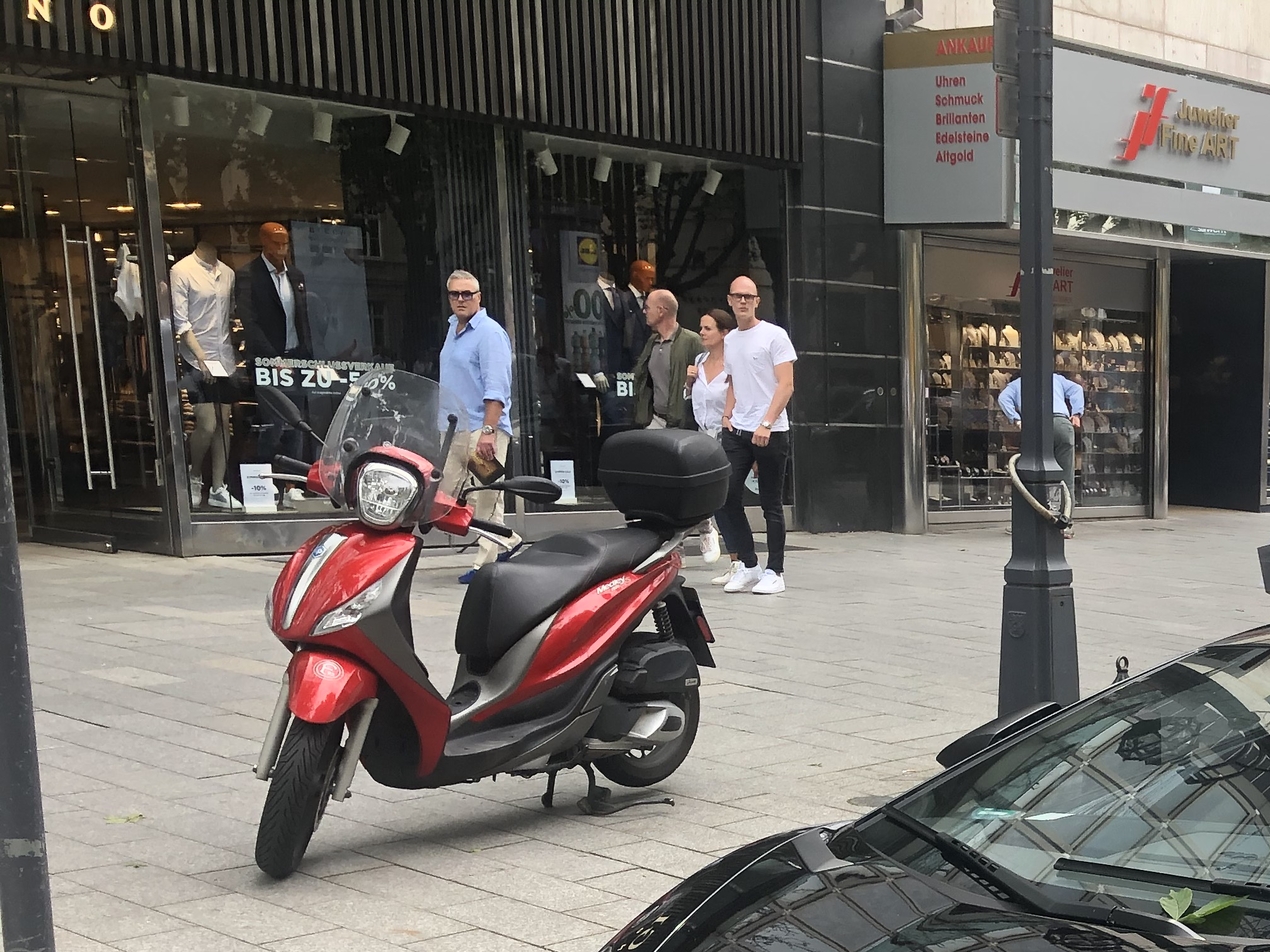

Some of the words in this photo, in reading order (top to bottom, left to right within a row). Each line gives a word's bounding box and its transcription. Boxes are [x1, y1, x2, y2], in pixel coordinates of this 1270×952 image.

[935, 75, 966, 88] Uhren
[935, 93, 984, 107] Schmuck
[935, 112, 986, 126] Brillanten
[1176, 99, 1240, 130] Juwelier
[935, 131, 990, 144] Edelsteine
[1159, 122, 1199, 154] Fine
[1200, 131, 1240, 160] ART
[935, 149, 974, 166] Altgold
[1052, 279, 1074, 293] ART
[255, 367, 295, 387] BIS
[301, 369, 332, 389] ZU
